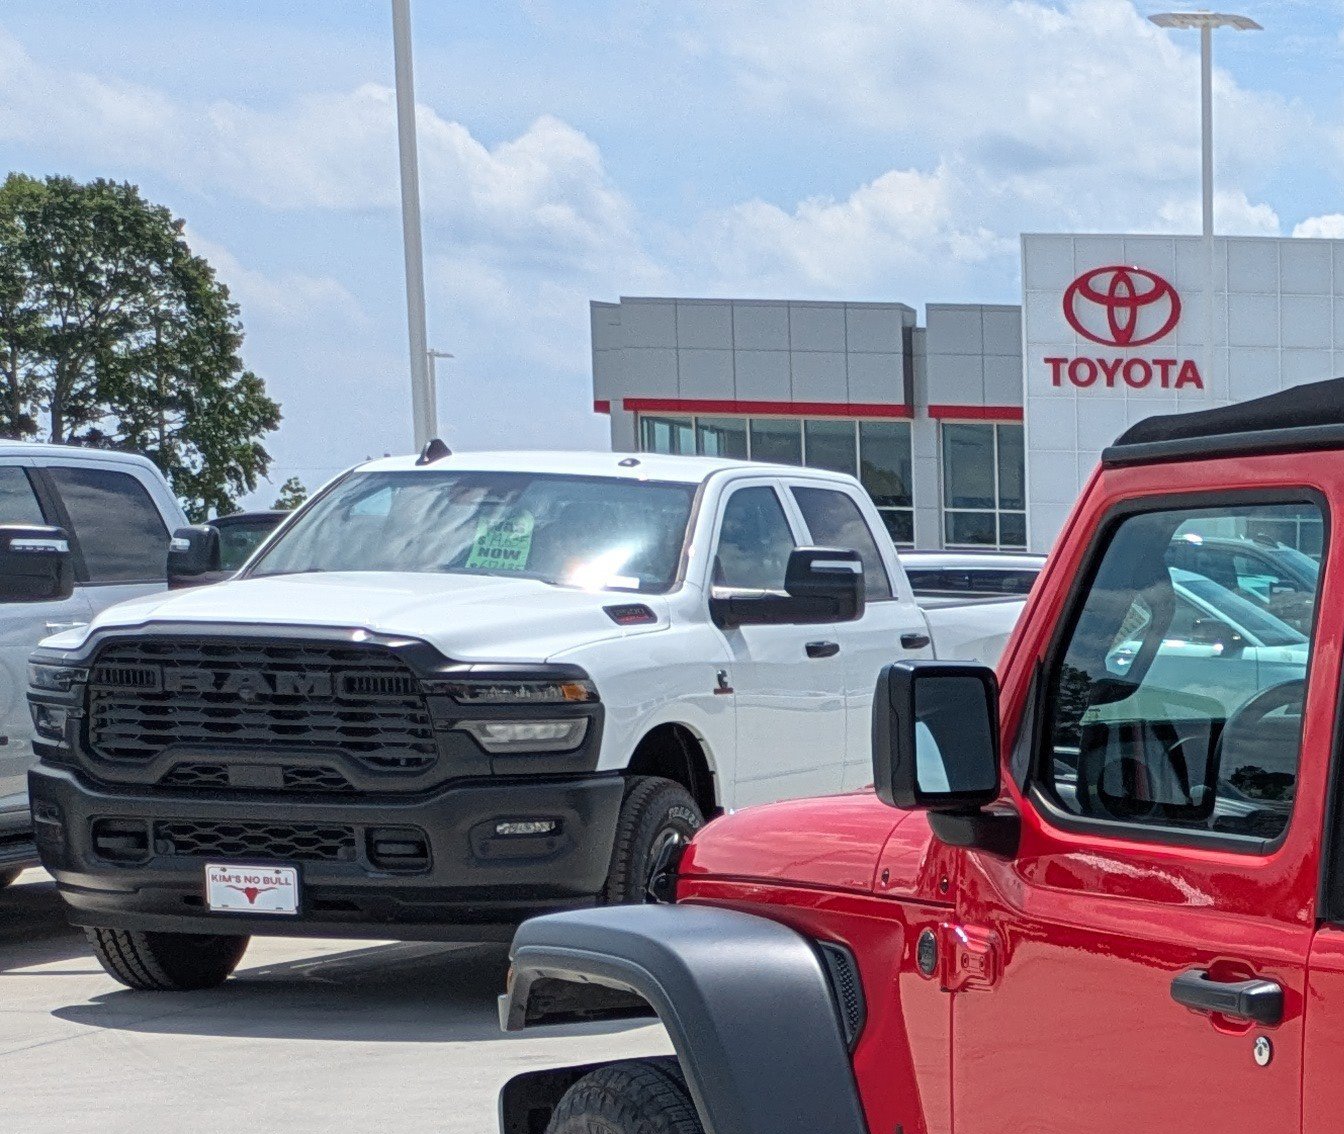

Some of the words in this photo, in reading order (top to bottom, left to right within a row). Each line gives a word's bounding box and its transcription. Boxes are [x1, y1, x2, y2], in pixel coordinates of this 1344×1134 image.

[1043, 356, 1205, 390] TOYOTA
[477, 547, 521, 561] NOW
[211, 874, 241, 884] KIM'S
[243, 875, 260, 885] NO
[262, 876, 292, 886] BULL
